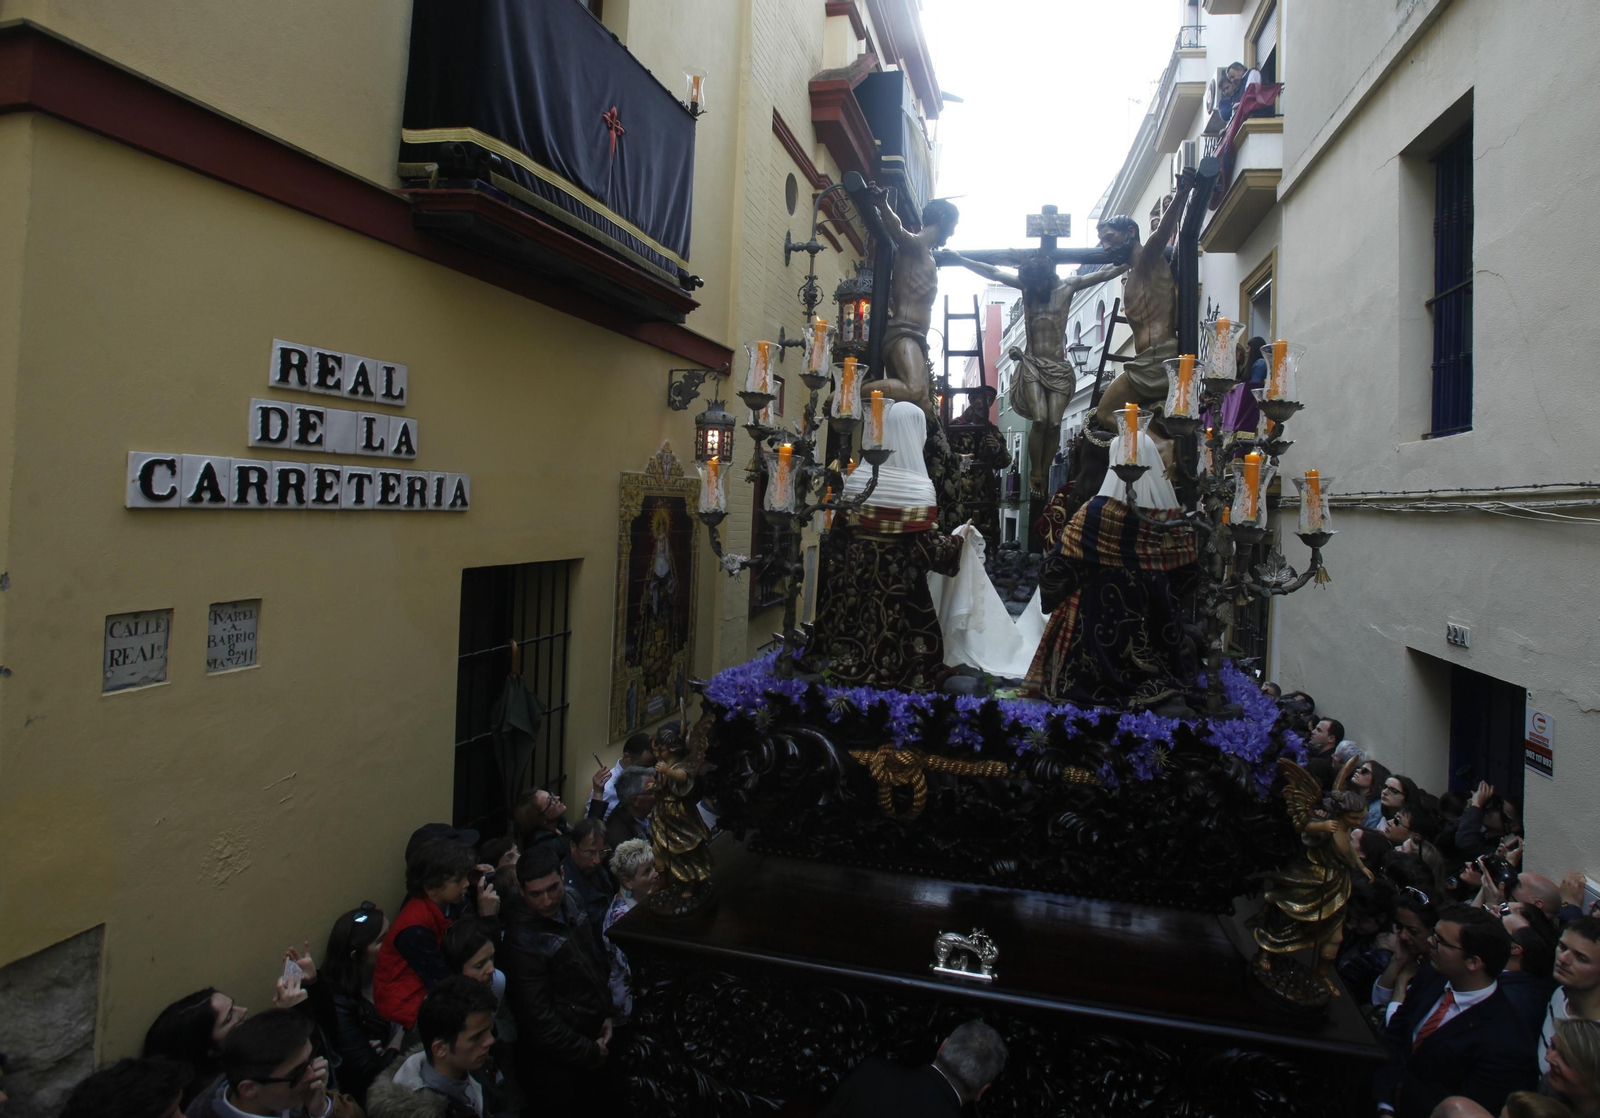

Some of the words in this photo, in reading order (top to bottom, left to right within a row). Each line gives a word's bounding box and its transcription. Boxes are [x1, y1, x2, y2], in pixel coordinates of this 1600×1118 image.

[276, 346, 405, 401] REAL
[256, 405, 324, 446] DE
[362, 416, 416, 456] LA
[138, 457, 469, 508] CARRETERIA
[109, 618, 165, 638] CALLE
[207, 631, 256, 649] BARRIO
[1446, 624, 1467, 647] 22A
[107, 643, 164, 668] REAL
